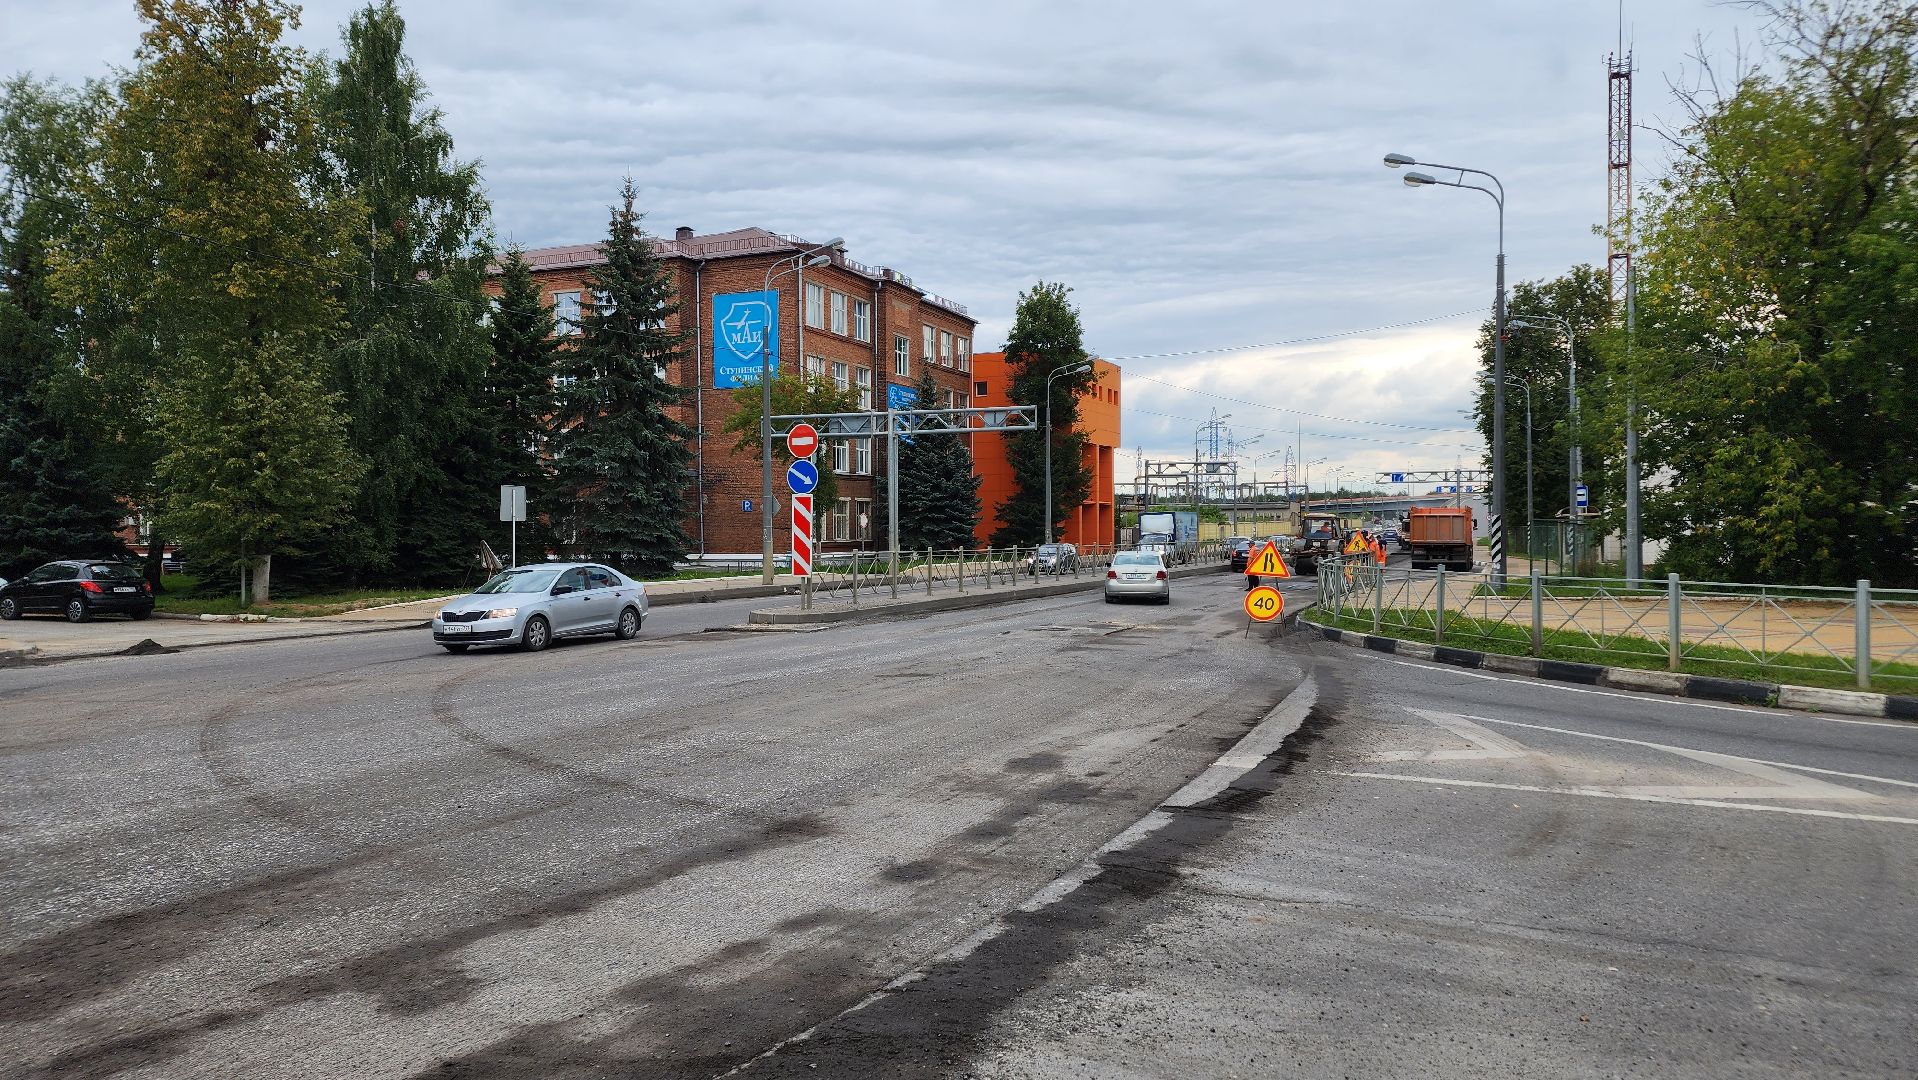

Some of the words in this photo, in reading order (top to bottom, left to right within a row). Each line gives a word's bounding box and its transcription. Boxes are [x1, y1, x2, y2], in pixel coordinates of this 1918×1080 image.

[732, 323, 761, 344] МАИ
[720, 364, 774, 375] СТУПИНСКЙ
[1254, 597, 1274, 610] 40
